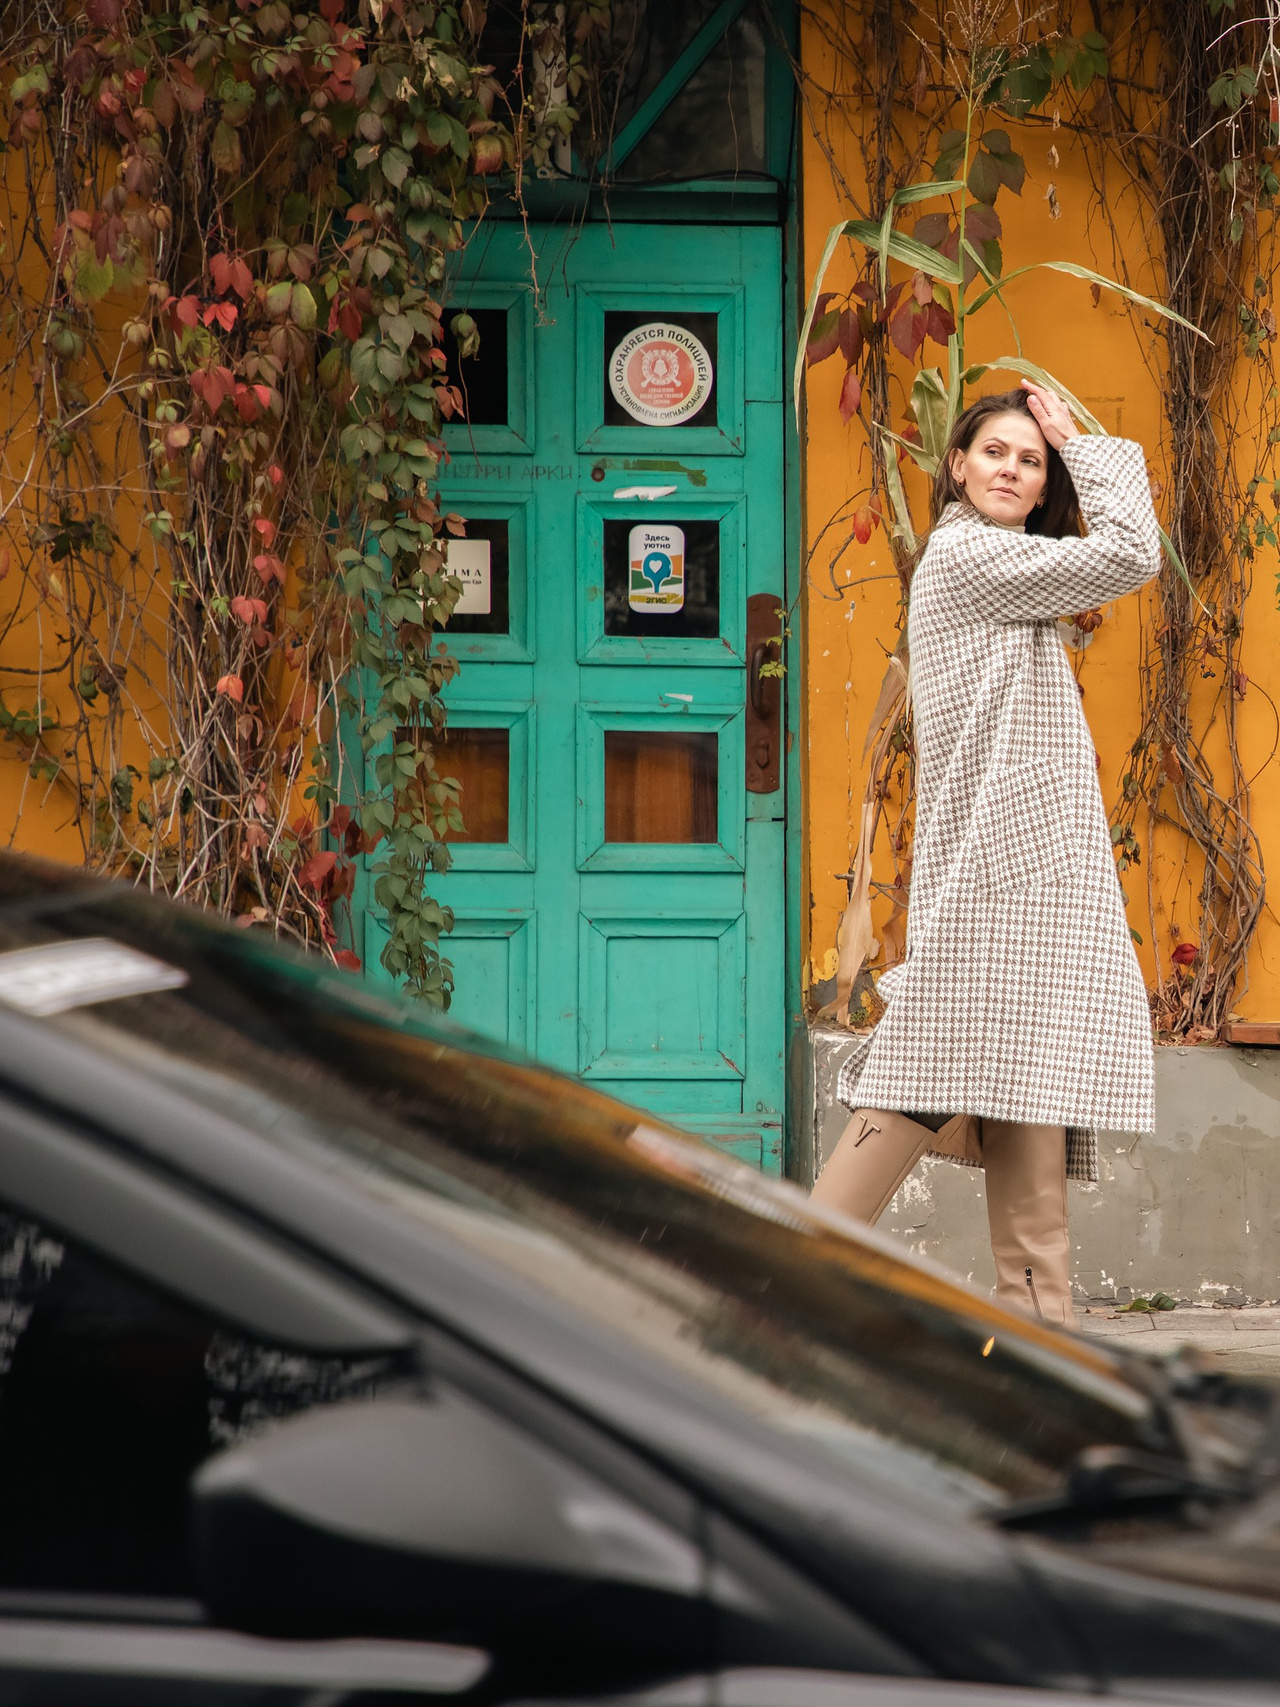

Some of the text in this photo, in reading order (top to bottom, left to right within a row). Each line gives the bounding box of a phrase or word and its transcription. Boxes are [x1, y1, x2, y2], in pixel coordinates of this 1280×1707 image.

[615, 329, 709, 382] ОХРАНЯЕТСЯ ПОЛИЦИЕЙ
[618, 384, 704, 419] УСТАНОВЛЕНА СИГНАЛИЗАЦИЯ
[436, 464, 573, 480] НУТРИ АРКИ
[644, 533, 670, 541] Здесь
